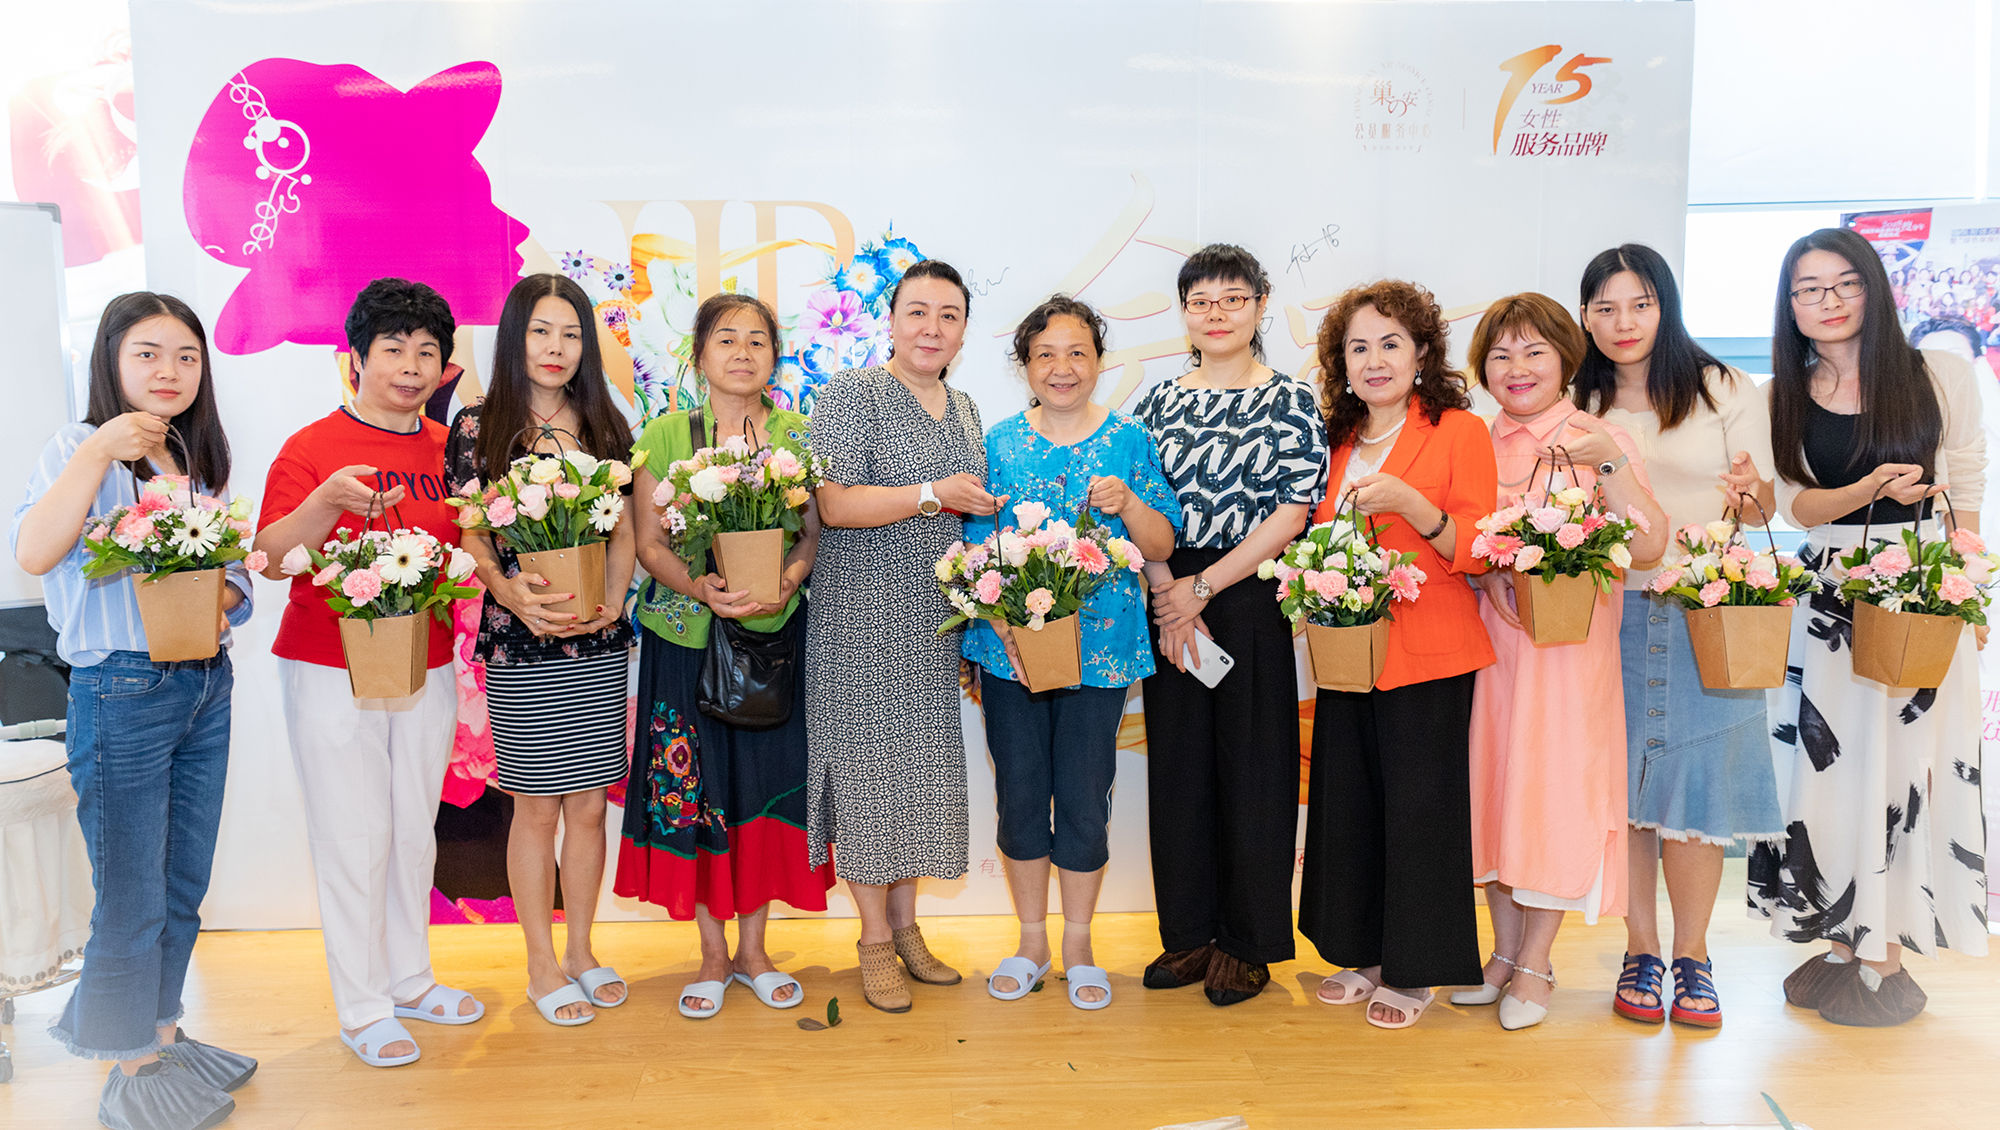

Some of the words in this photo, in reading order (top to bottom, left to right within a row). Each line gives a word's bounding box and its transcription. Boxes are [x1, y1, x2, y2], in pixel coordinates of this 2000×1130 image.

[1531, 83, 1563, 95] YEAR
[1518, 108, 1562, 130] 女性
[1509, 131, 1609, 157] 服务品牌
